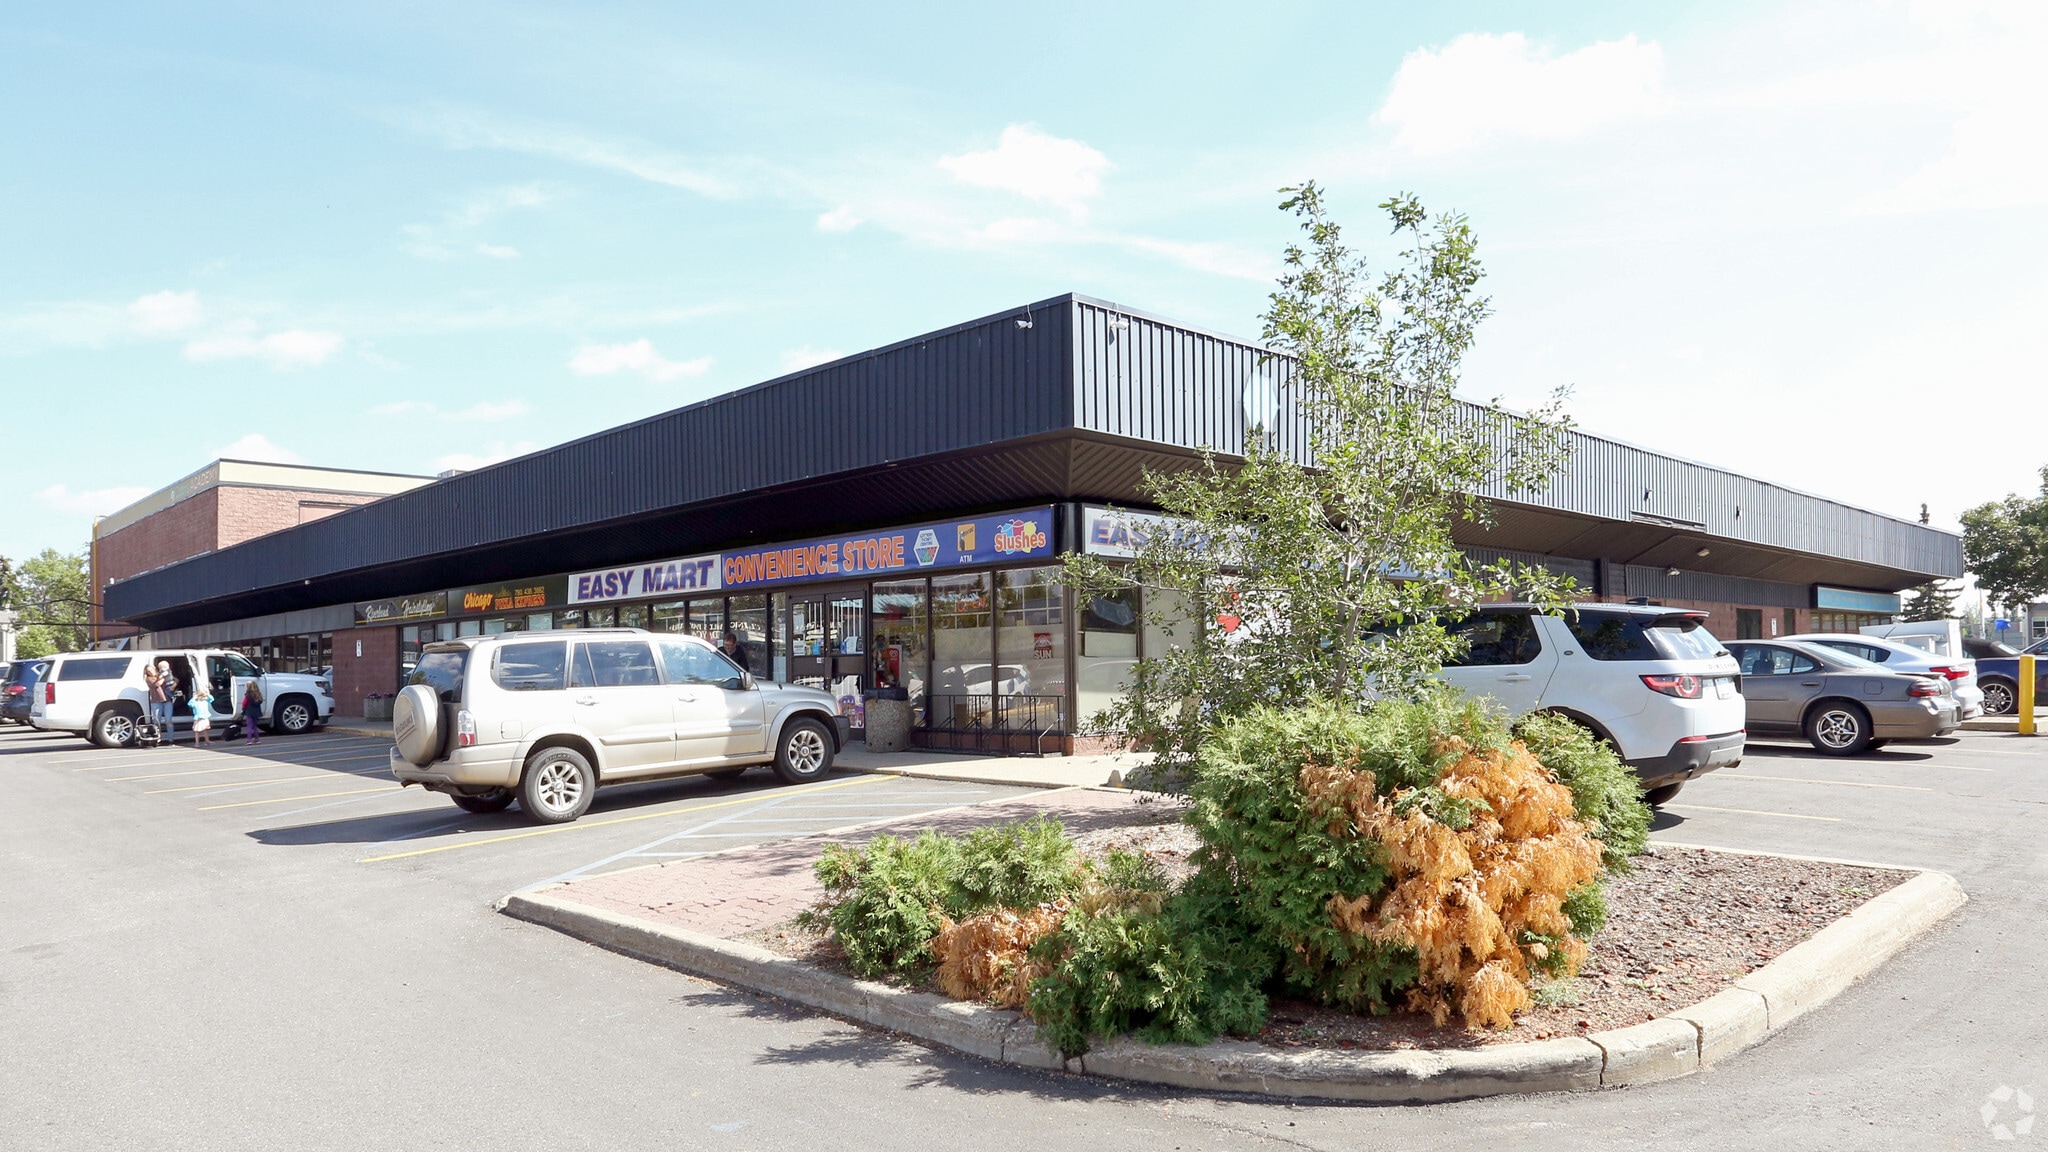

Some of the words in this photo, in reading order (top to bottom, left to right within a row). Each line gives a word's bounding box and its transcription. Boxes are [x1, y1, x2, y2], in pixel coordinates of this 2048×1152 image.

[994, 531, 1047, 553] Slushes
[724, 543, 839, 585] CONVENIENCE
[842, 535, 905, 572] STORE
[959, 554, 973, 563] ATM
[577, 569, 635, 601] EASY
[641, 559, 715, 594] MART
[463, 592, 493, 611] Chicago
[495, 597, 514, 611] PIZZA
[514, 594, 546, 609] EXPRESS
[1034, 650, 1052, 659] SUN
